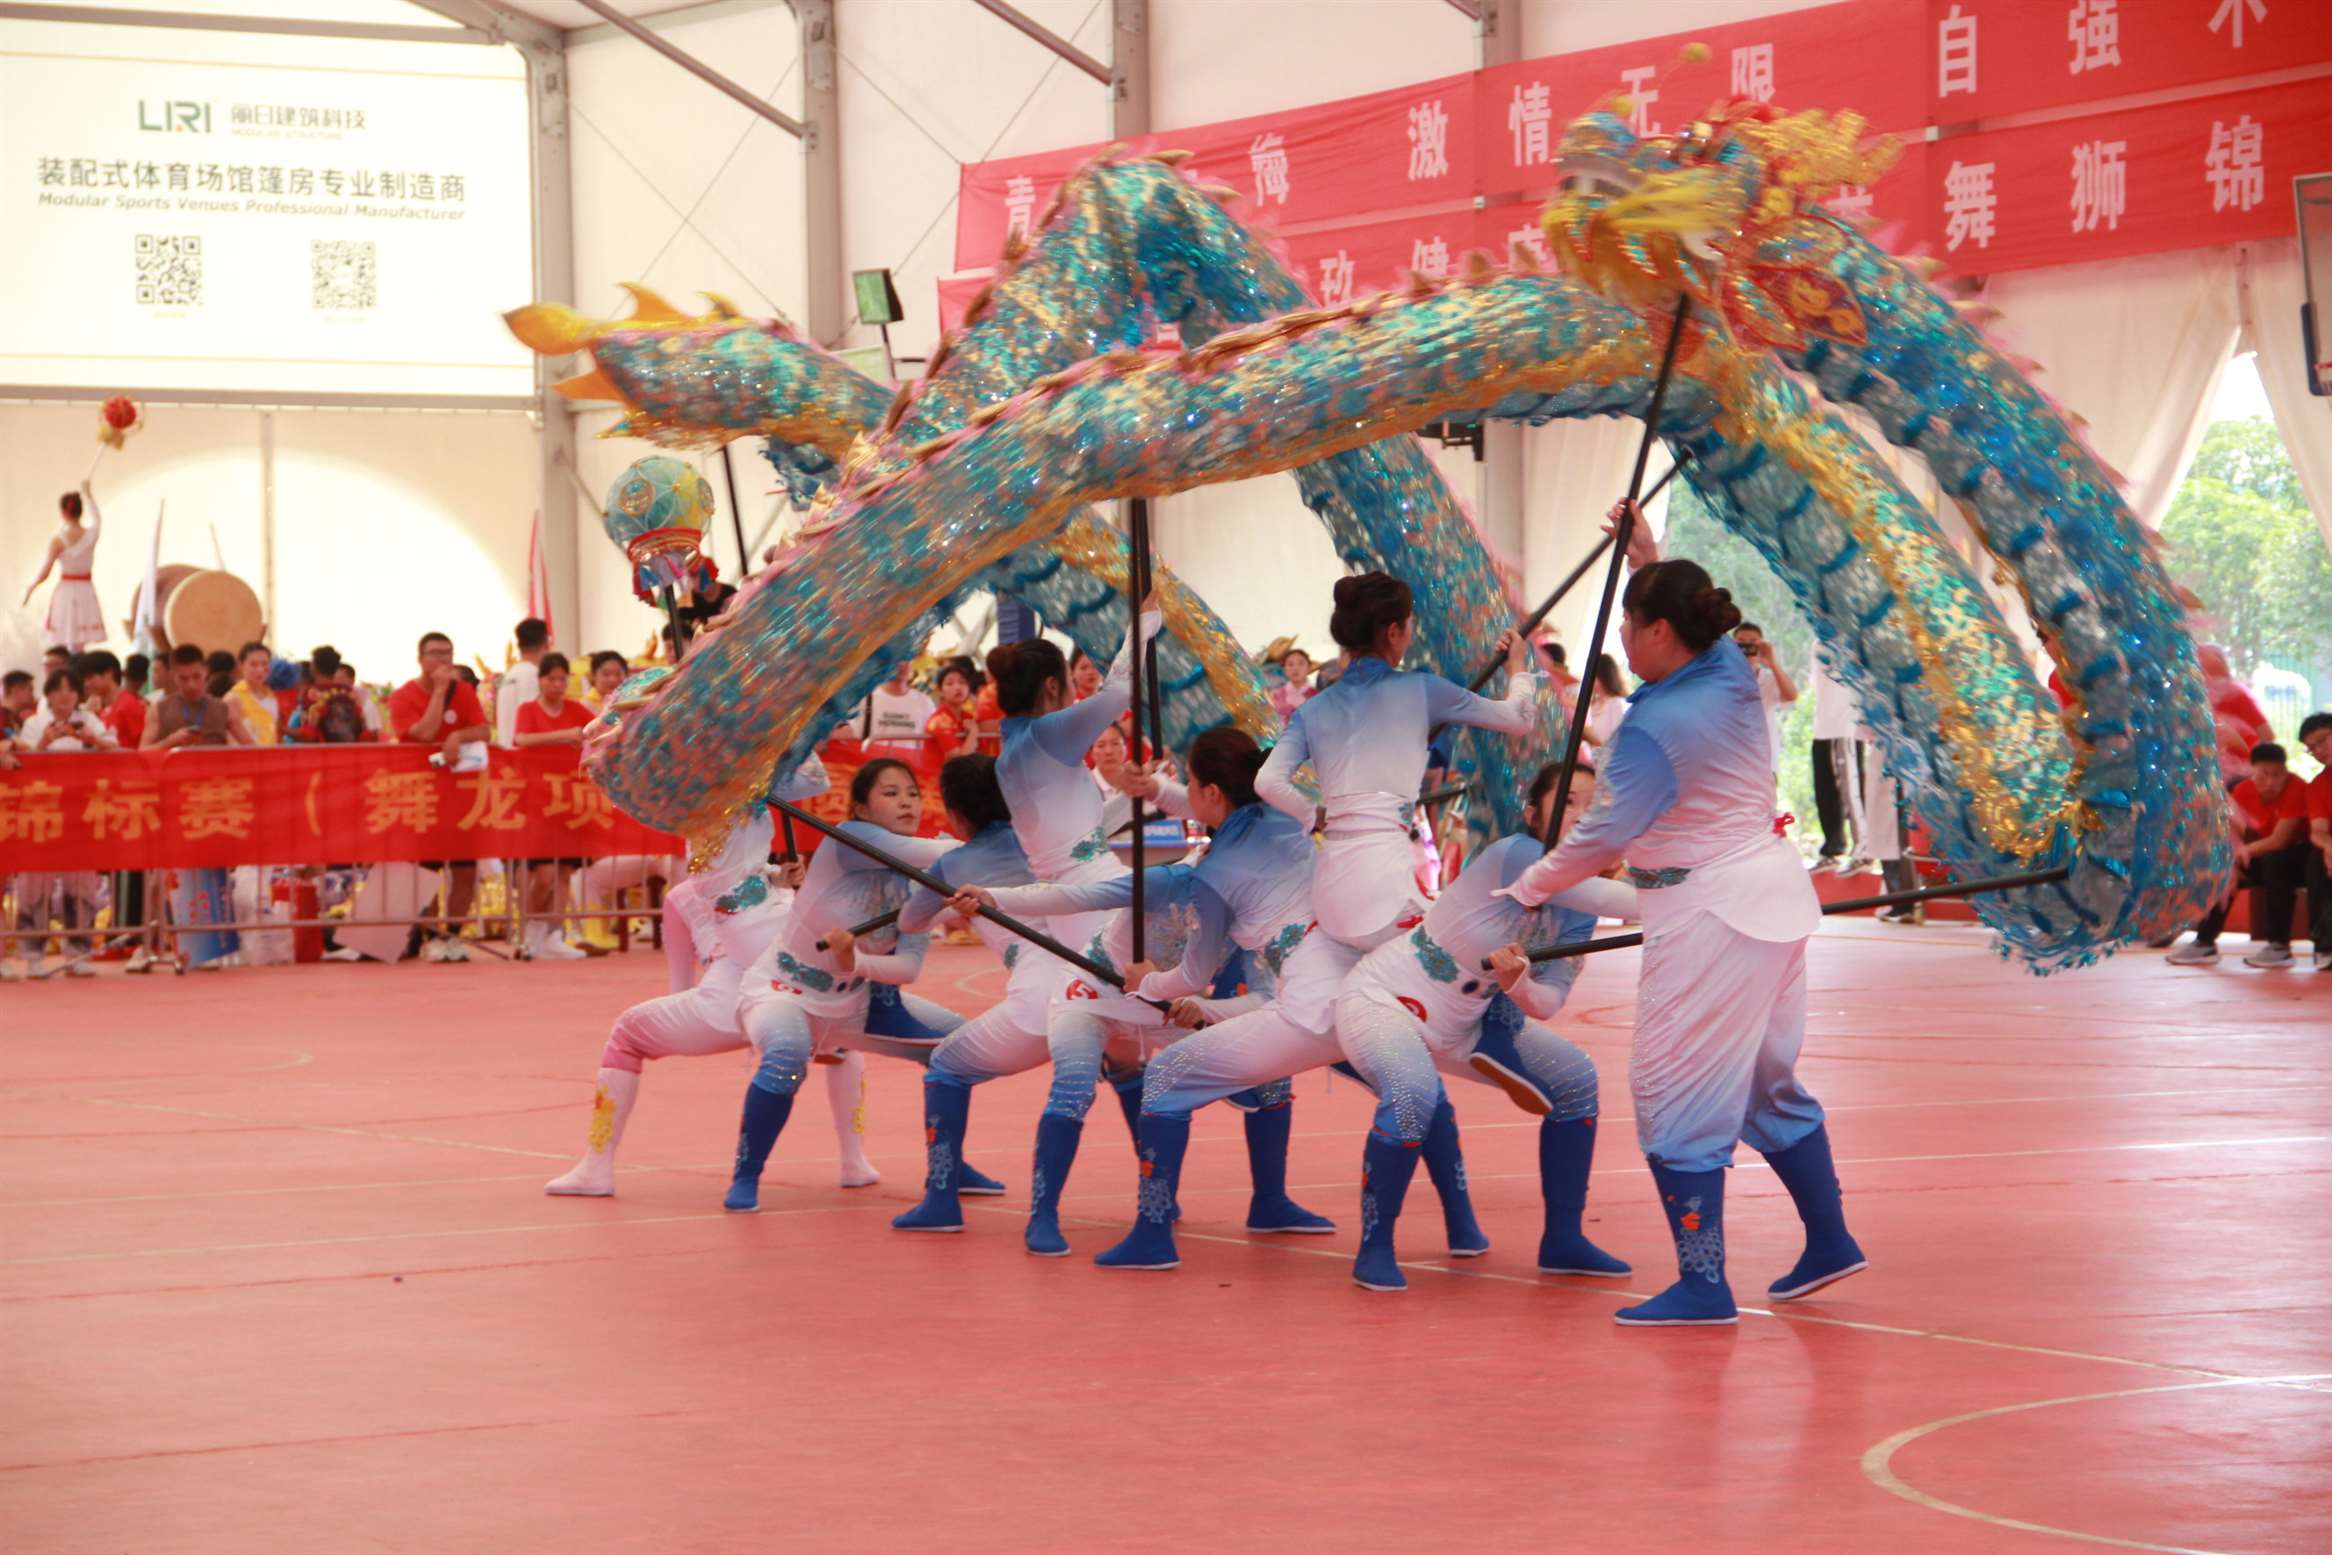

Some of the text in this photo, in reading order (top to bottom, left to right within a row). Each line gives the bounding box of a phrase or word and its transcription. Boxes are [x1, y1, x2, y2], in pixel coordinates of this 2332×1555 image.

[138, 100, 211, 133] LIRI
[38, 192, 465, 221] Modular Sports Venues Professional Manufacturer
